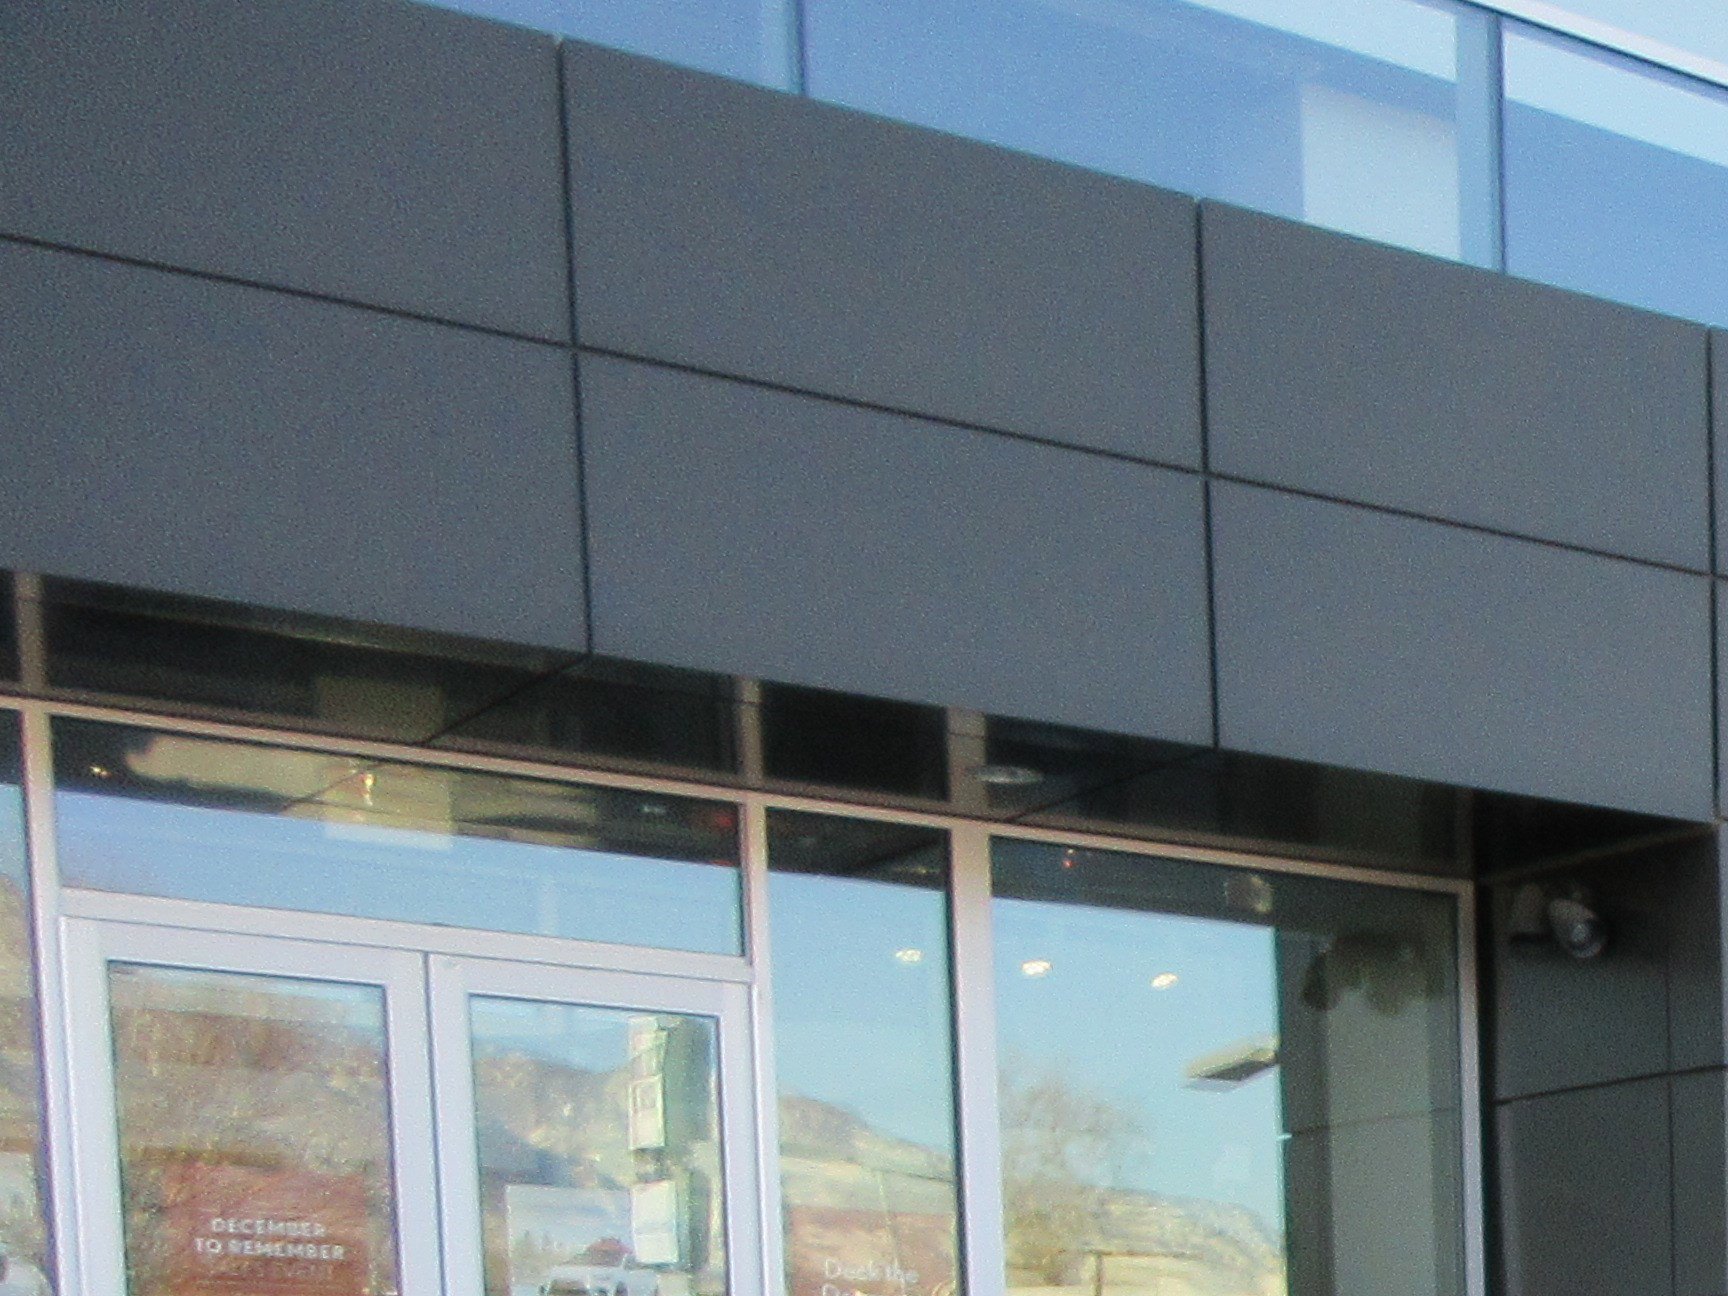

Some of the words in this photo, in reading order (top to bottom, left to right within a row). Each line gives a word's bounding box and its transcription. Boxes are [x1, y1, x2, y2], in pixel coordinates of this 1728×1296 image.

[211, 1217, 327, 1238] DECEMBER
[194, 1237, 222, 1254] TO
[227, 1239, 345, 1260] REMEMBER
